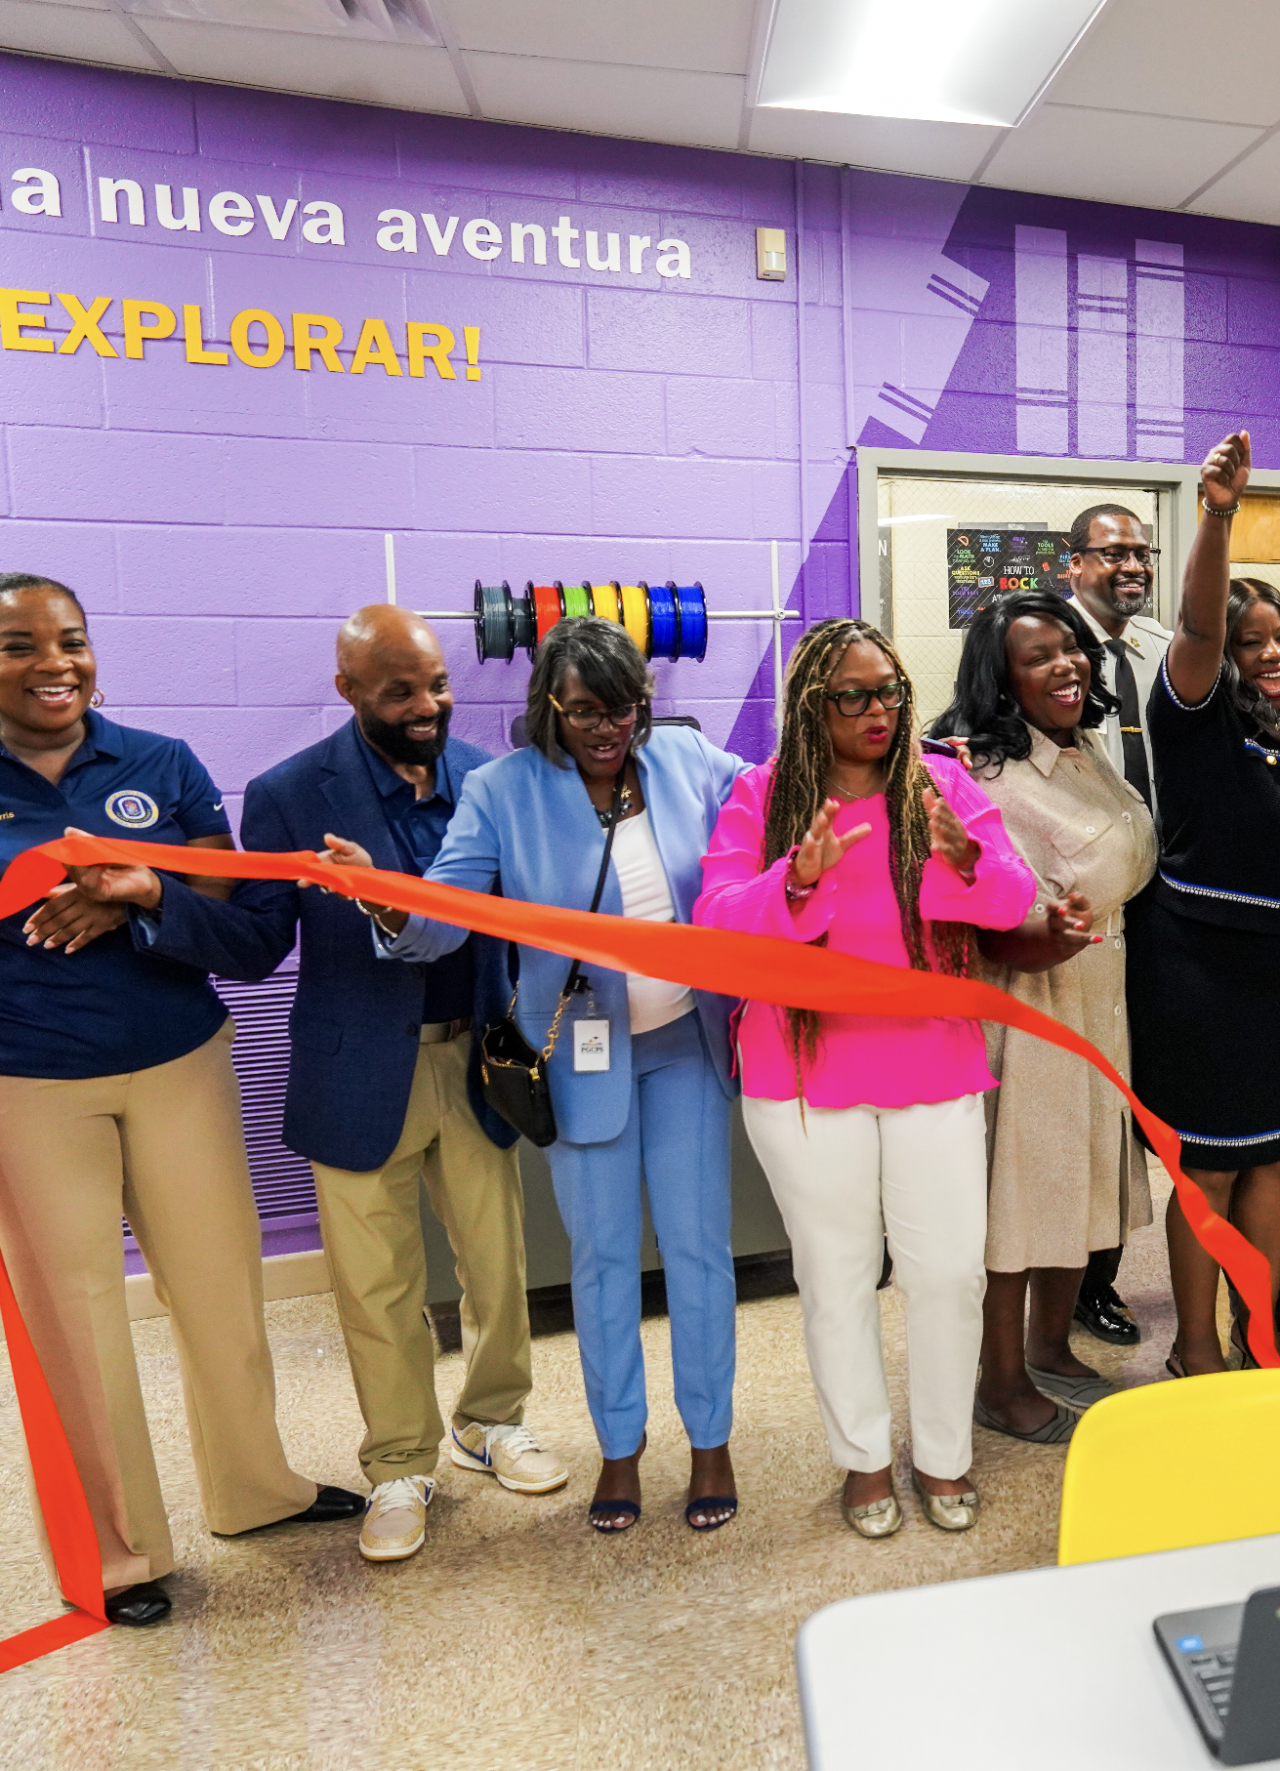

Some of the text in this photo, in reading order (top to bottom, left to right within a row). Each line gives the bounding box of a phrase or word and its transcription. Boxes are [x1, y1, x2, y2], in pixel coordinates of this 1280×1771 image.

[0, 168, 692, 280] a nueva aventura
[0, 287, 482, 382] EXPLORAR!
[1003, 565, 1035, 576] HOW TO
[980, 578, 992, 586] 123
[998, 577, 1039, 590] ROCK
